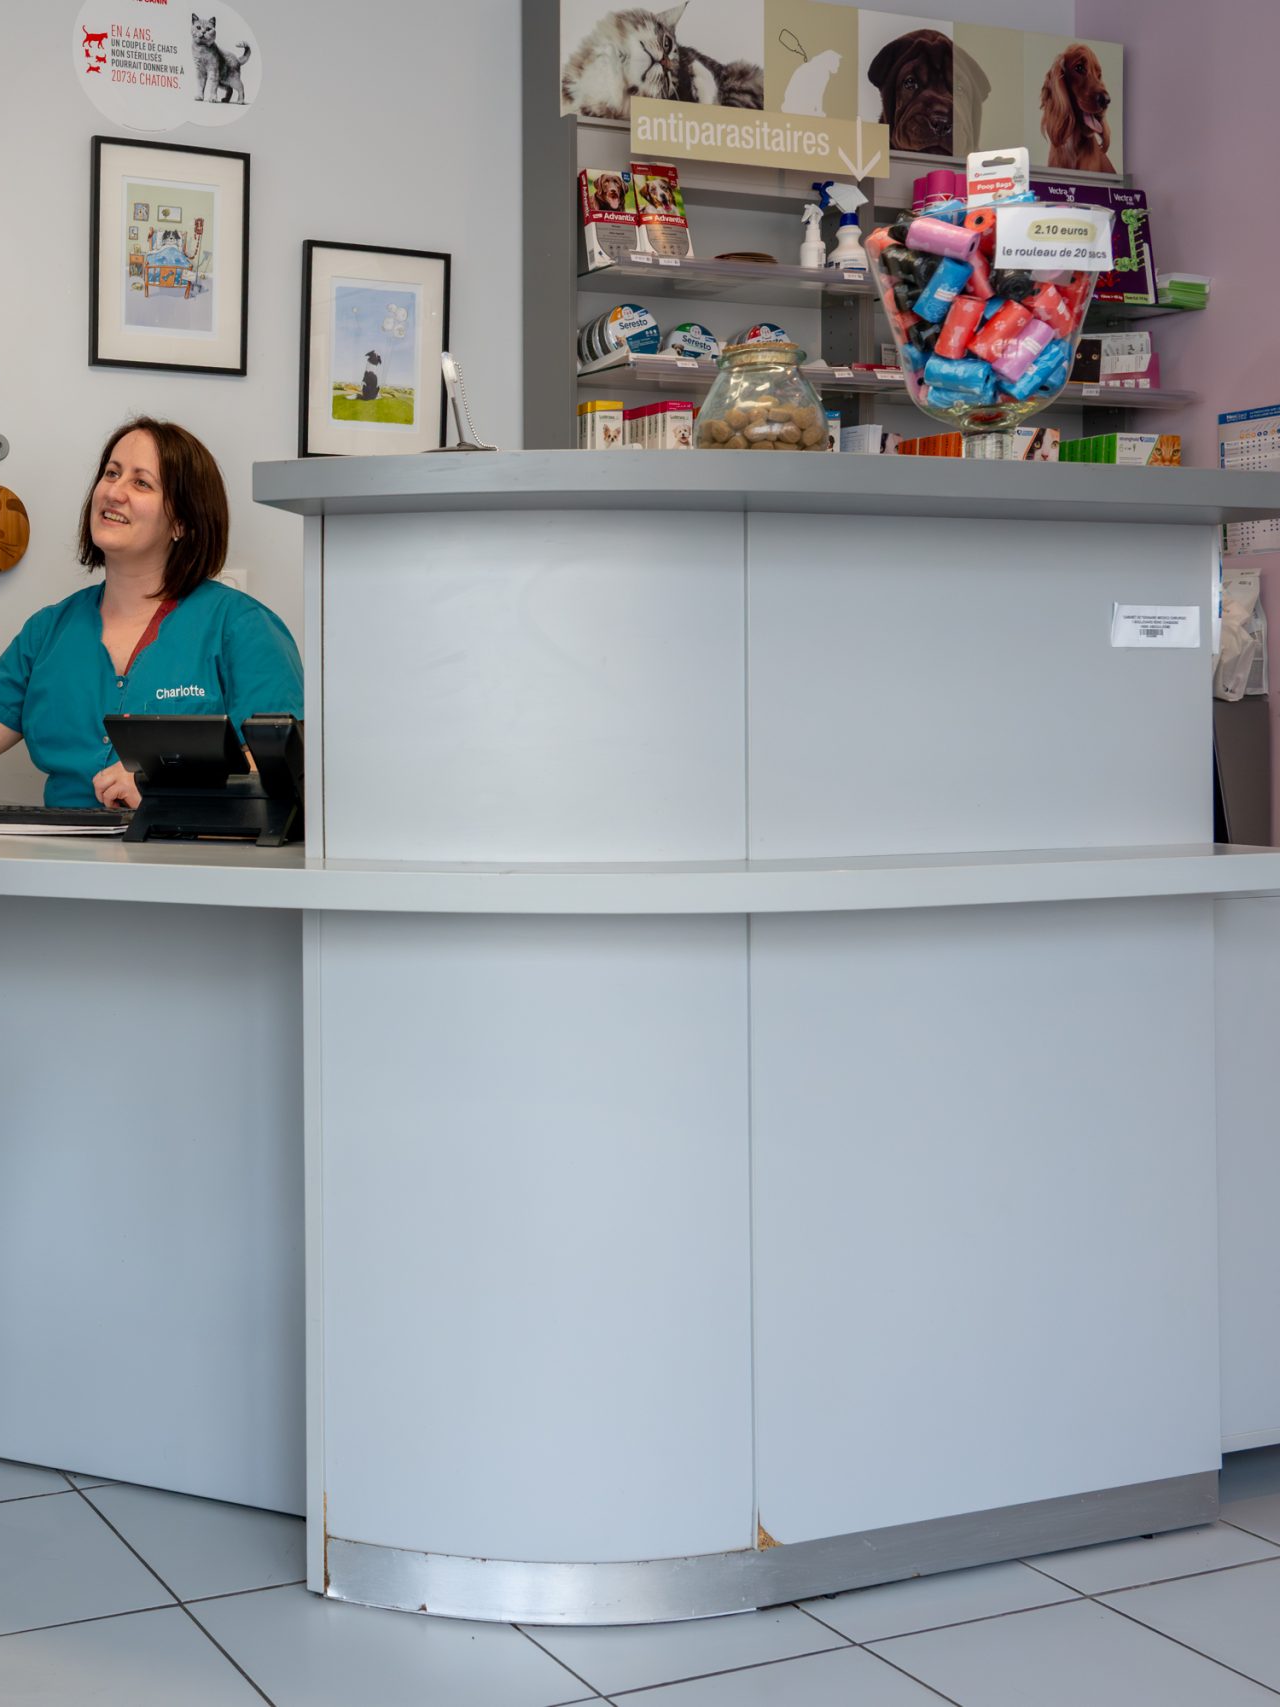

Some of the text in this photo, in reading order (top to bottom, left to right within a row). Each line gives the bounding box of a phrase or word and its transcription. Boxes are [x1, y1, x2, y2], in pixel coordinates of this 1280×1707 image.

[111, 24, 123, 38] EN
[126, 26, 131, 39] 4
[111, 39, 178, 54] UN COUPLE DE CHATS
[111, 49, 125, 58] NON
[111, 59, 142, 70] POURRAIT
[144, 62, 168, 73] DONNER
[169, 65, 178, 74] VIE
[111, 70, 137, 84] 20736
[636, 113, 831, 156] antiparasitaires
[976, 182, 994, 191] Poop
[1048, 187, 1068, 196] Vectra
[1113, 194, 1133, 202] Vectra
[604, 212, 636, 222] Advantix
[654, 214, 685, 224] Advantix
[1034, 225, 1089, 236] 2.10 euros
[1002, 246, 1106, 259] le rouleau de 20 sacs
[618, 319, 648, 330] Seresto
[682, 334, 712, 352] Seresto
[156, 684, 206, 700] Charlotte
